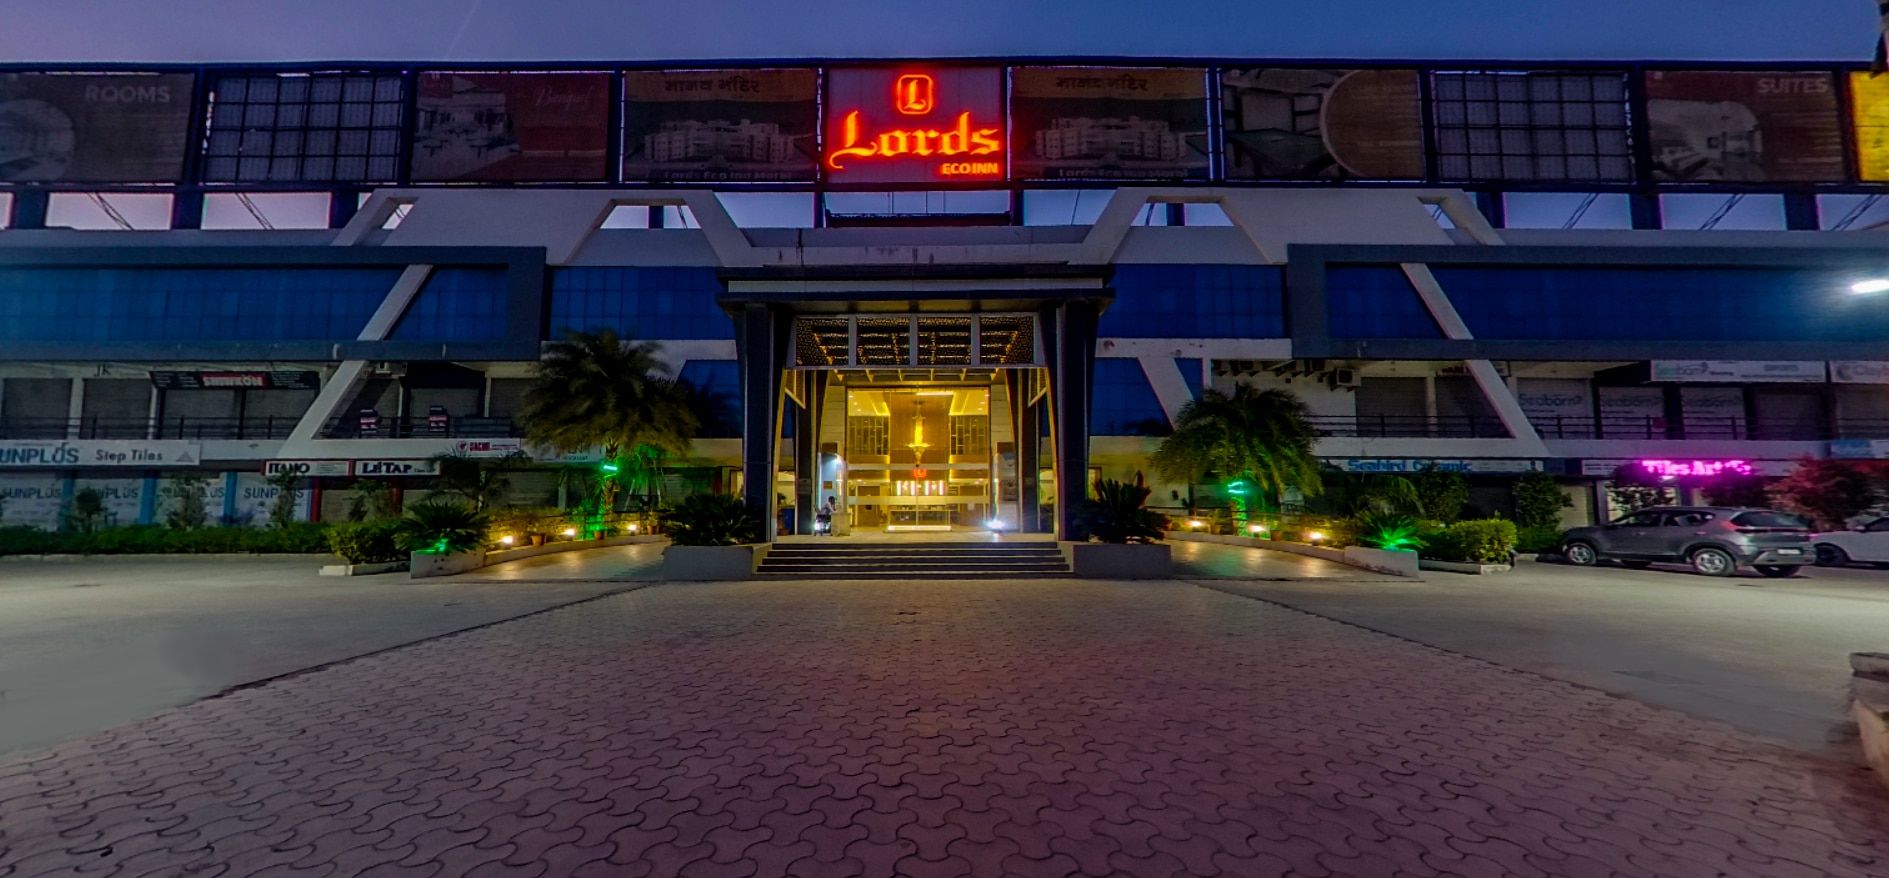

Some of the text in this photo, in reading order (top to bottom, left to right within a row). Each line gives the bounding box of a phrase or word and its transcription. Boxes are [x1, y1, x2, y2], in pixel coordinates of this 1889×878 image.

[1757, 77, 1828, 93] SUITES
[85, 85, 170, 102] ROOMS
[829, 110, 999, 169] Lords
[0, 446, 79, 464] UNPLUS
[96, 448, 163, 464] Step Tiles
[243, 487, 305, 499] SUNPS
